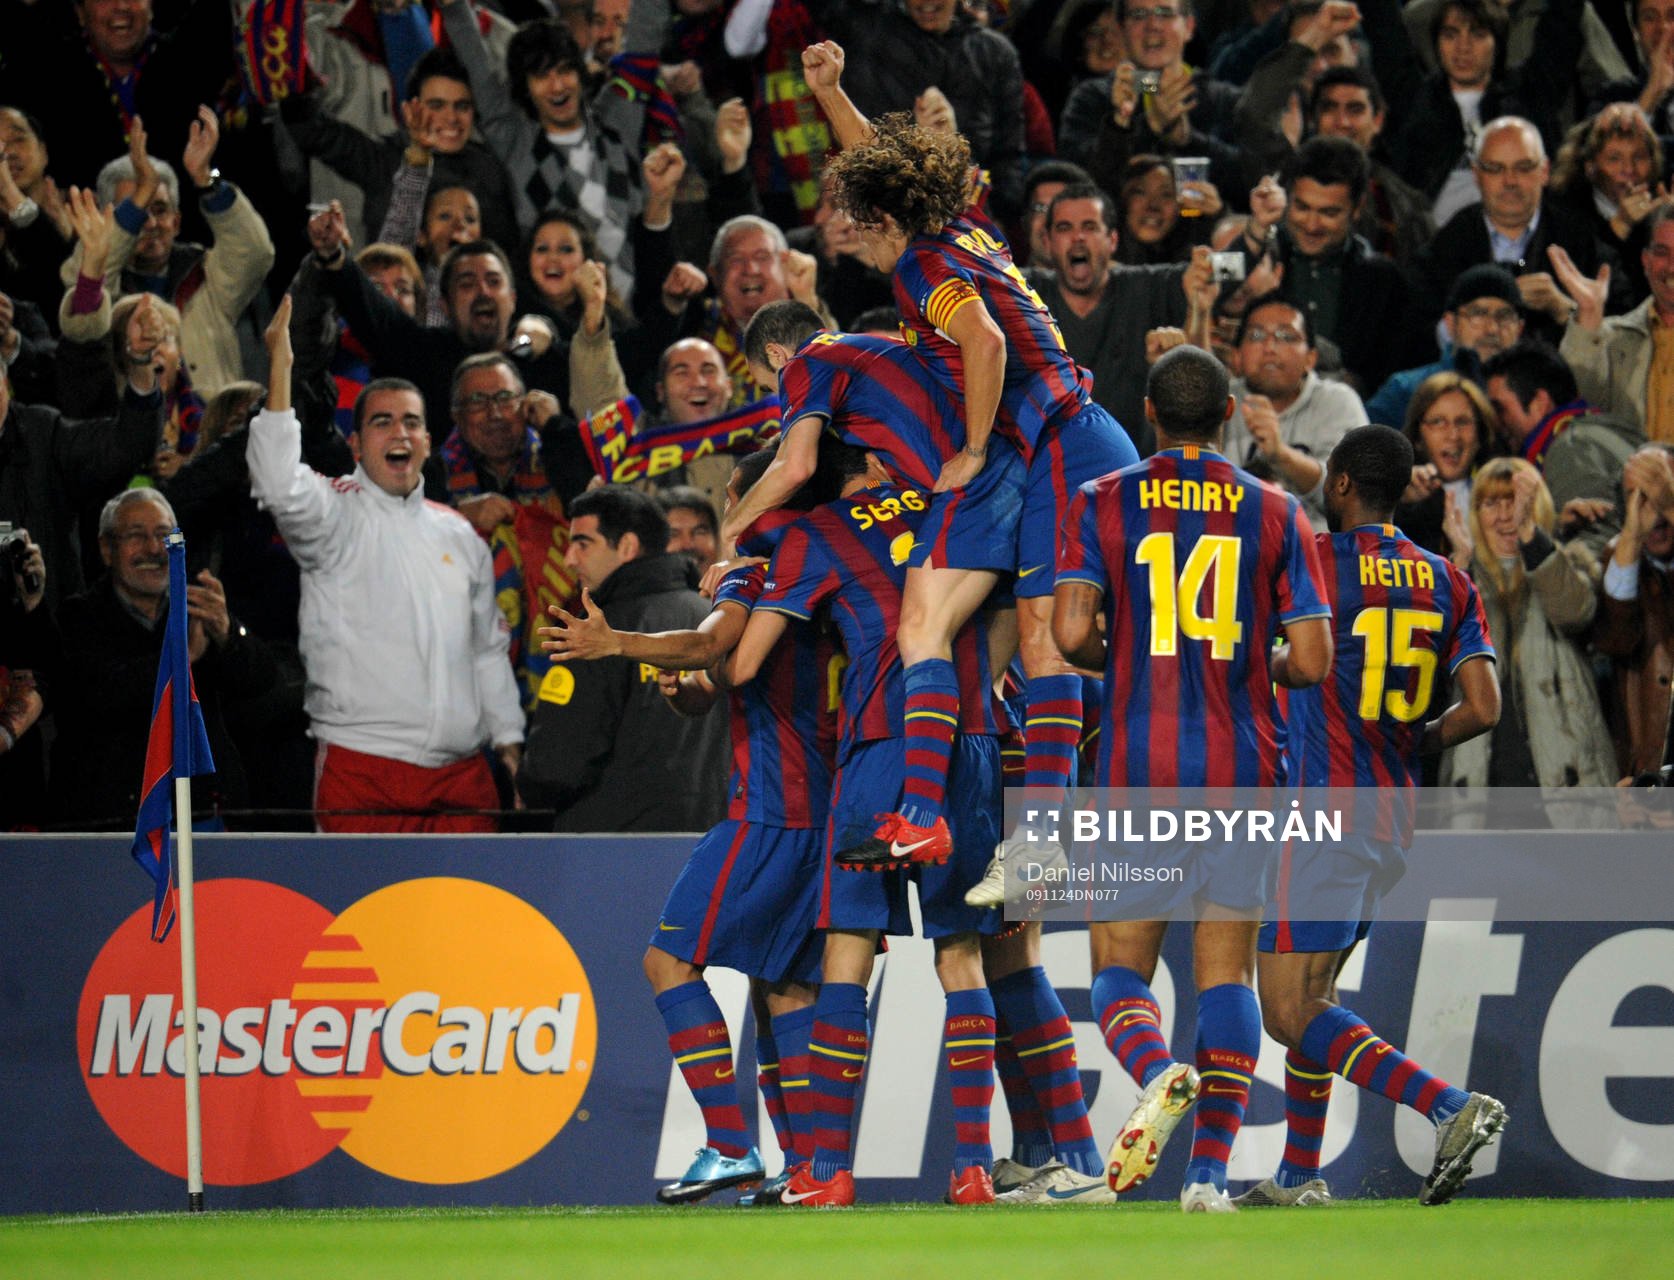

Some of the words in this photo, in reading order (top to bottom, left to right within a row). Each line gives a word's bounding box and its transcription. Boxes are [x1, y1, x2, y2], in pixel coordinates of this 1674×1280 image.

[1139, 479, 1244, 513] HENRY
[1359, 554, 1435, 590] KEITA
[1135, 532, 1243, 661] 14
[1351, 607, 1444, 723] 15
[90, 991, 581, 1075] MasterCard
[950, 1019, 986, 1030] BARÇA
[1210, 1054, 1251, 1068] BARÇA
